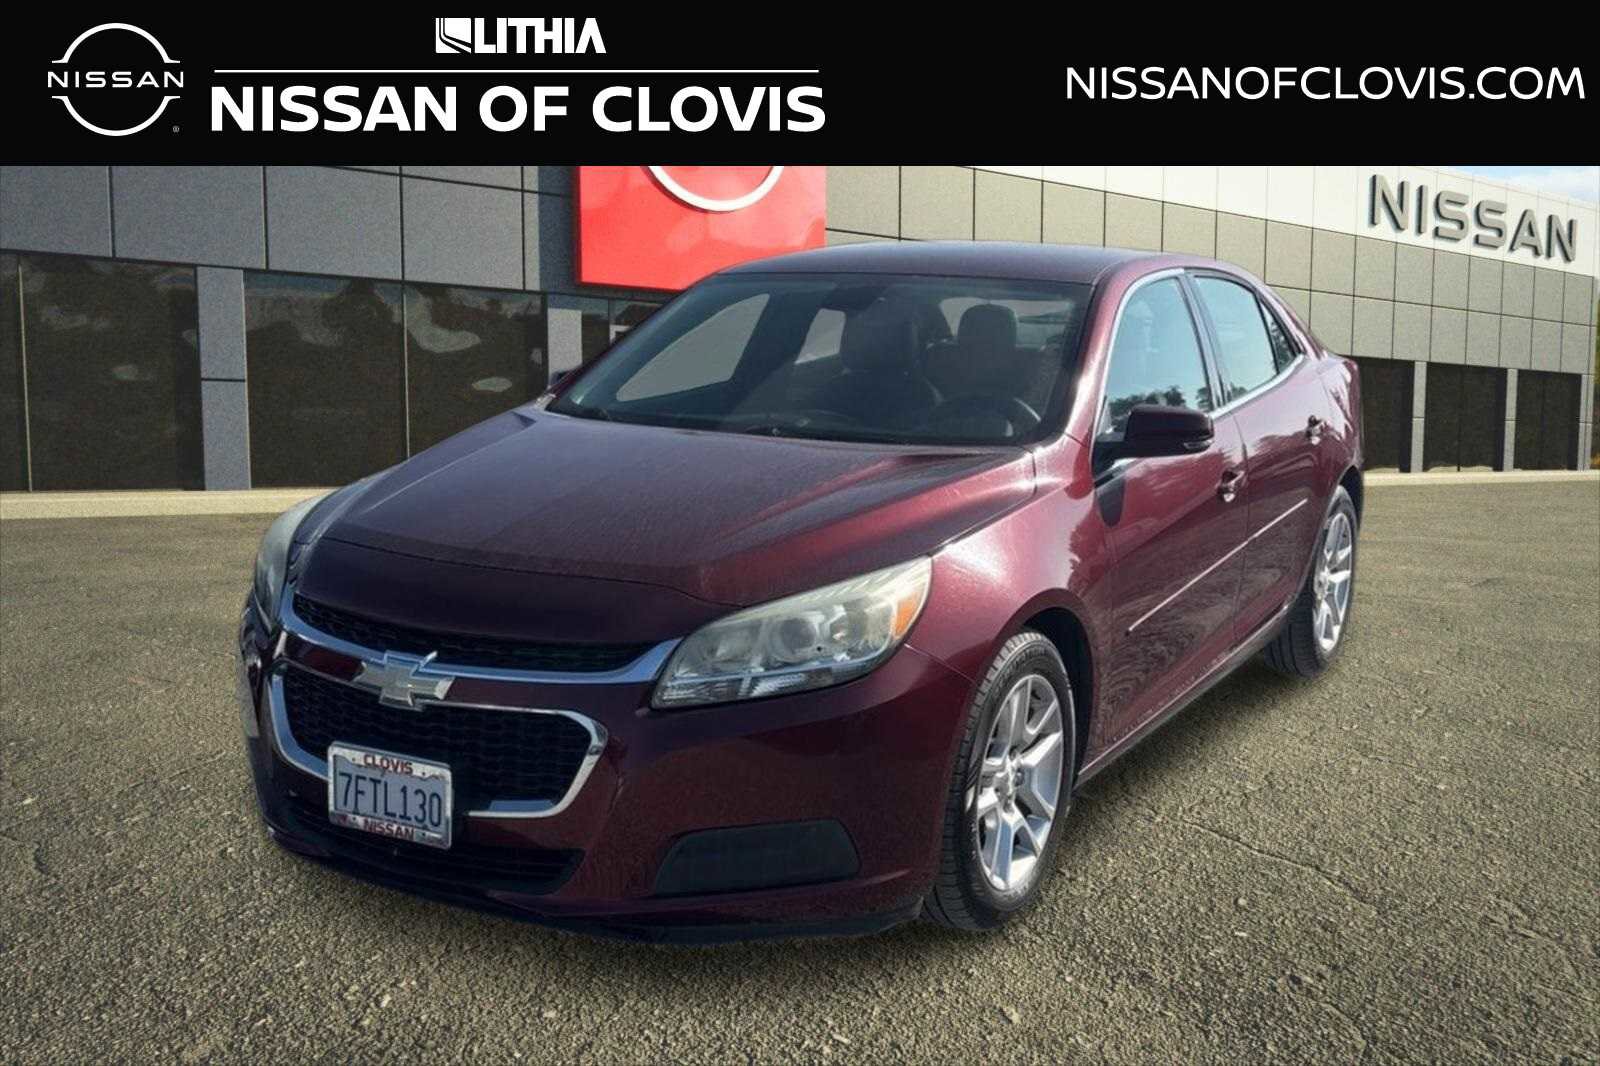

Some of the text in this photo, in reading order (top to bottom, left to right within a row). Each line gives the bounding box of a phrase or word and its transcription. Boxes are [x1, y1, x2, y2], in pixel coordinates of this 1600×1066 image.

[1368, 174, 1578, 262] NISSAN
[363, 753, 414, 775] CLOVIS
[339, 772, 443, 828] 7FTL130
[363, 818, 416, 841] NISSAN
